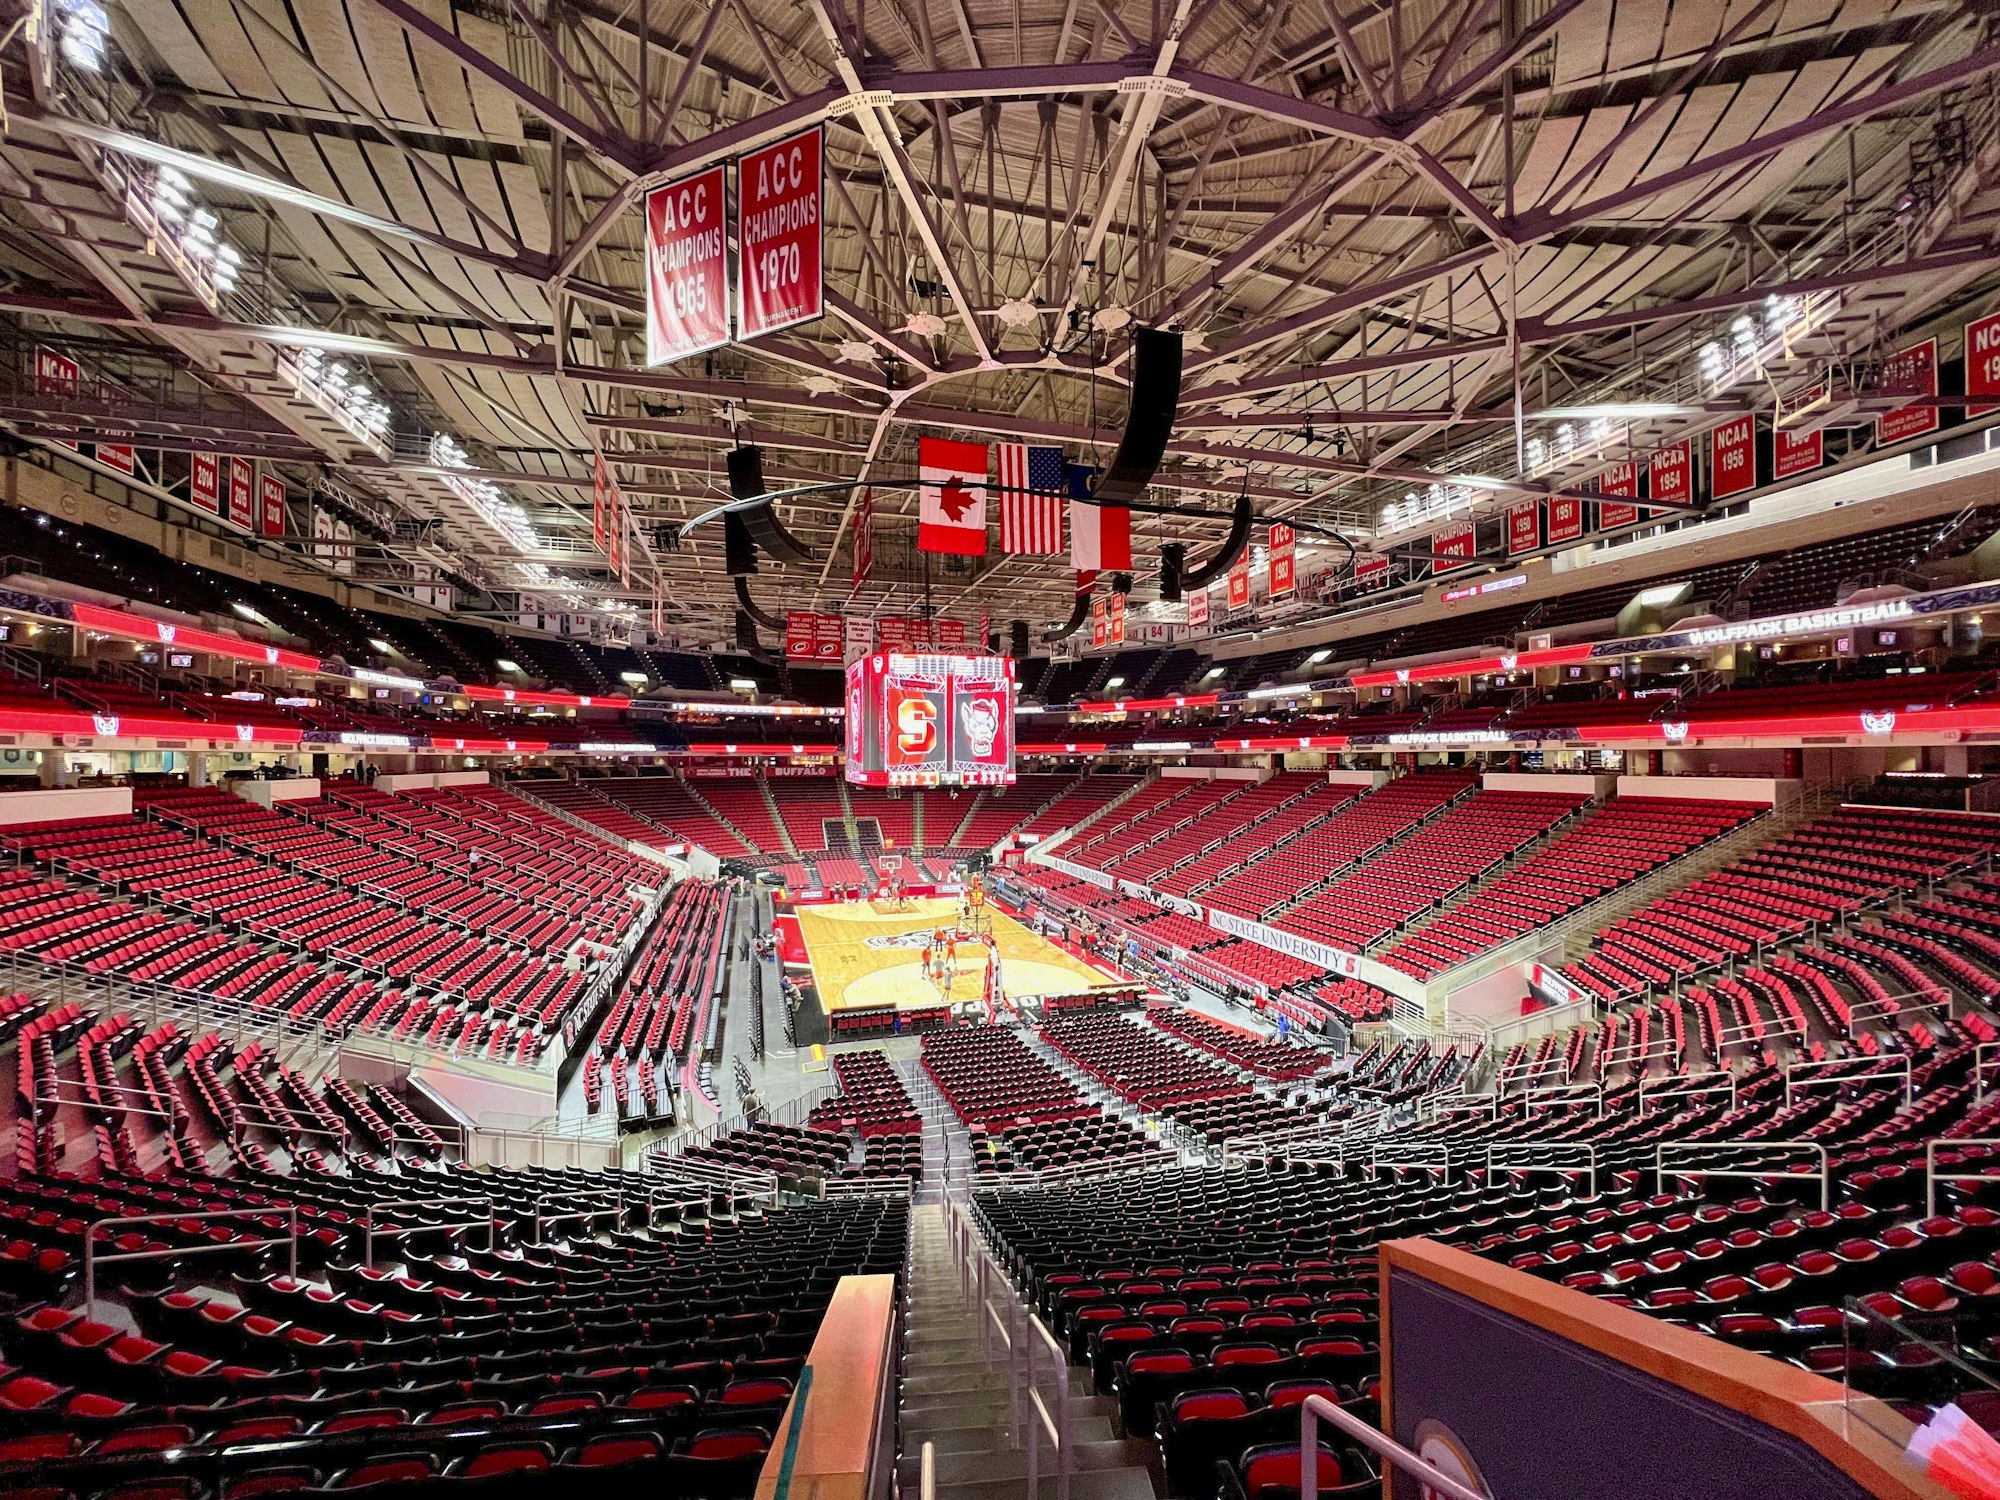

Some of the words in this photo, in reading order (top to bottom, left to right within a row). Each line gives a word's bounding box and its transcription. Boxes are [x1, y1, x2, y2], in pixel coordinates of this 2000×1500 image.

[757, 146, 802, 202] ACC
[664, 183, 707, 234] ACC
[744, 192, 816, 248] CHAMPIONS
[653, 226, 720, 275] CHAMPIONS
[760, 242, 800, 292] 1970
[668, 272, 706, 318] 1965
[1718, 422, 1748, 450] NCAA
[1654, 449, 1686, 471] NCAA
[1722, 448, 1744, 472] 1956
[233, 462, 249, 486] NCAA
[1604, 464, 1632, 487] NCAA
[1660, 470, 1680, 492] 1954
[264, 482, 282, 503] NCAA
[1512, 500, 1534, 516] NCAA
[1556, 502, 1572, 521] 1951
[1434, 522, 1473, 544] CHAMPIONS
[1516, 516, 1531, 532] 1950
[1274, 526, 1289, 545] ACC
[576, 616, 584, 625] 13
[1688, 620, 1783, 645] WOLFPACK
[1785, 601, 1913, 633] BASKETBALL
[1152, 626, 1162, 638] 84
[914, 642, 944, 653] PNC
[1389, 733, 1439, 744] WOLFPACK
[1440, 731, 1509, 743] BASKETBALL
[728, 768, 751, 776] THE
[775, 767, 826, 776] BUFFALO
[1213, 912, 1226, 928] NC
[1228, 918, 1260, 940] STATE
[1262, 928, 1342, 968] UNIVERSITY
[574, 1007, 584, 1036] NC
